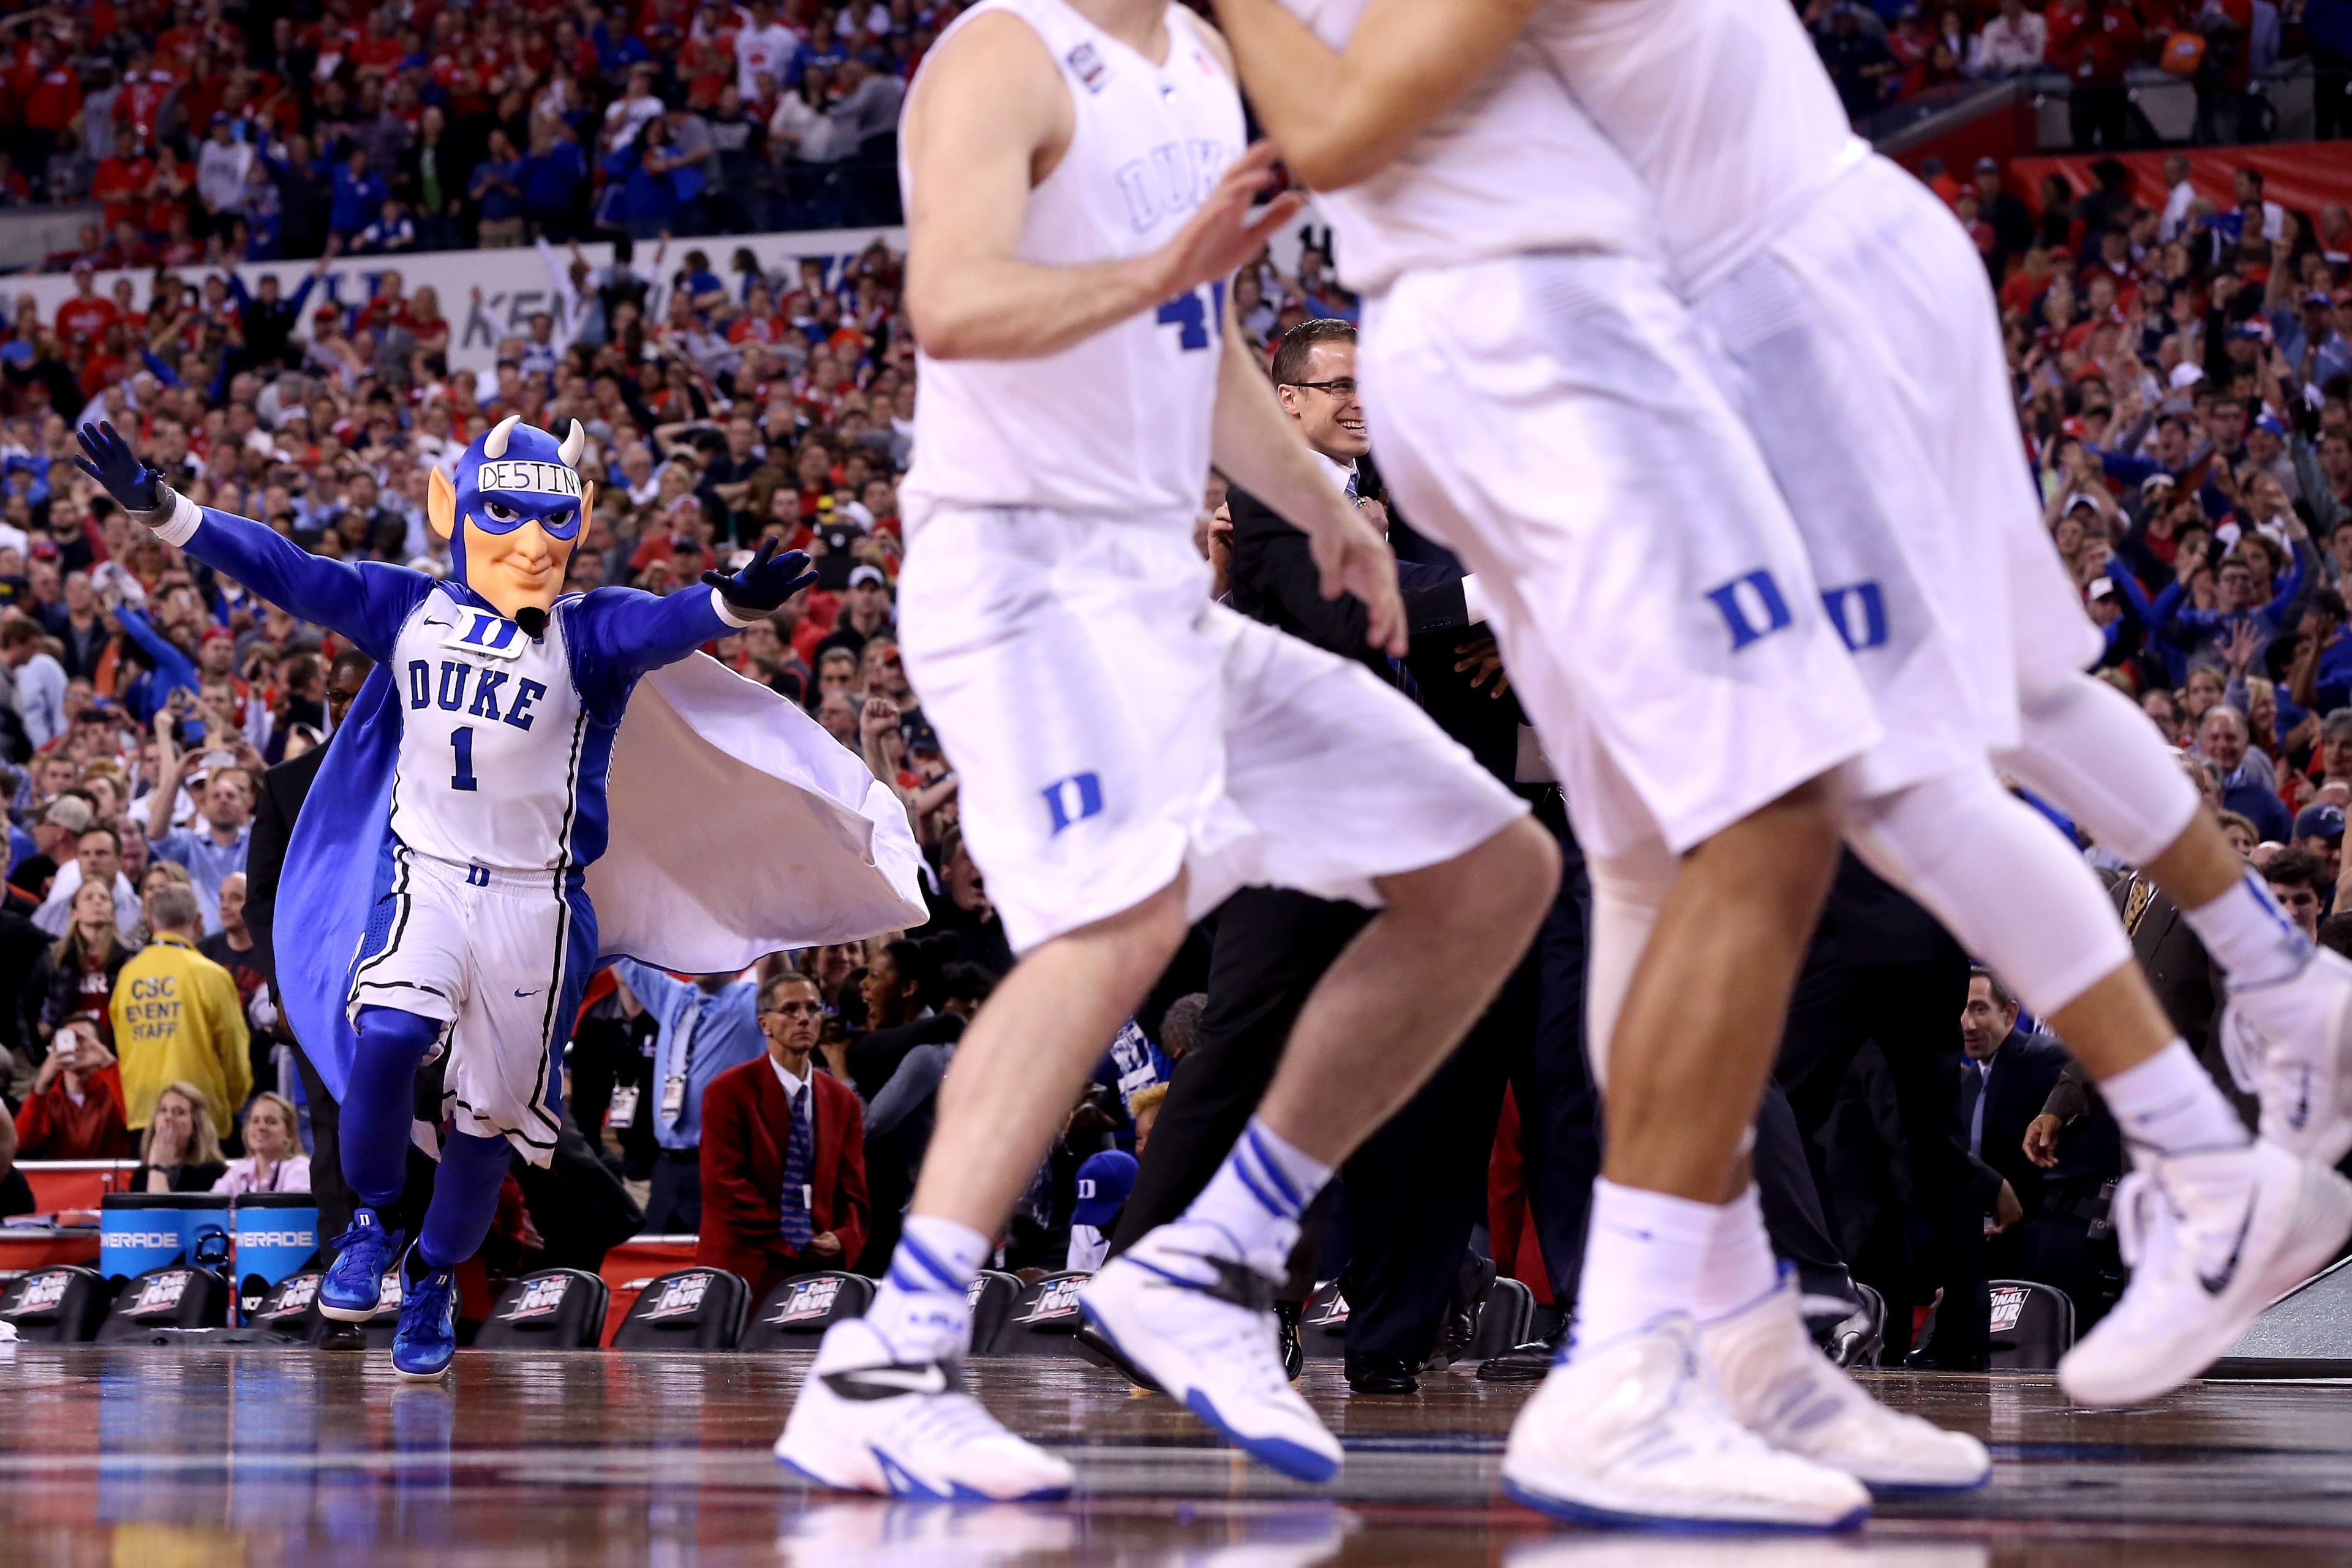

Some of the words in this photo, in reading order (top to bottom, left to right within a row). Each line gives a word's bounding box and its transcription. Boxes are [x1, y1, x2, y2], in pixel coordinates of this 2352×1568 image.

[1115, 136, 1238, 235] DUK
[1156, 279, 1224, 350] 4
[459, 614, 519, 650] D
[409, 659, 548, 732] DUKE
[450, 726, 478, 791] 1
[1041, 771, 1103, 837] D
[131, 976, 176, 1000] CSC
[1078, 1179, 1096, 1199] D
[1990, 1303, 2021, 1323] UR
